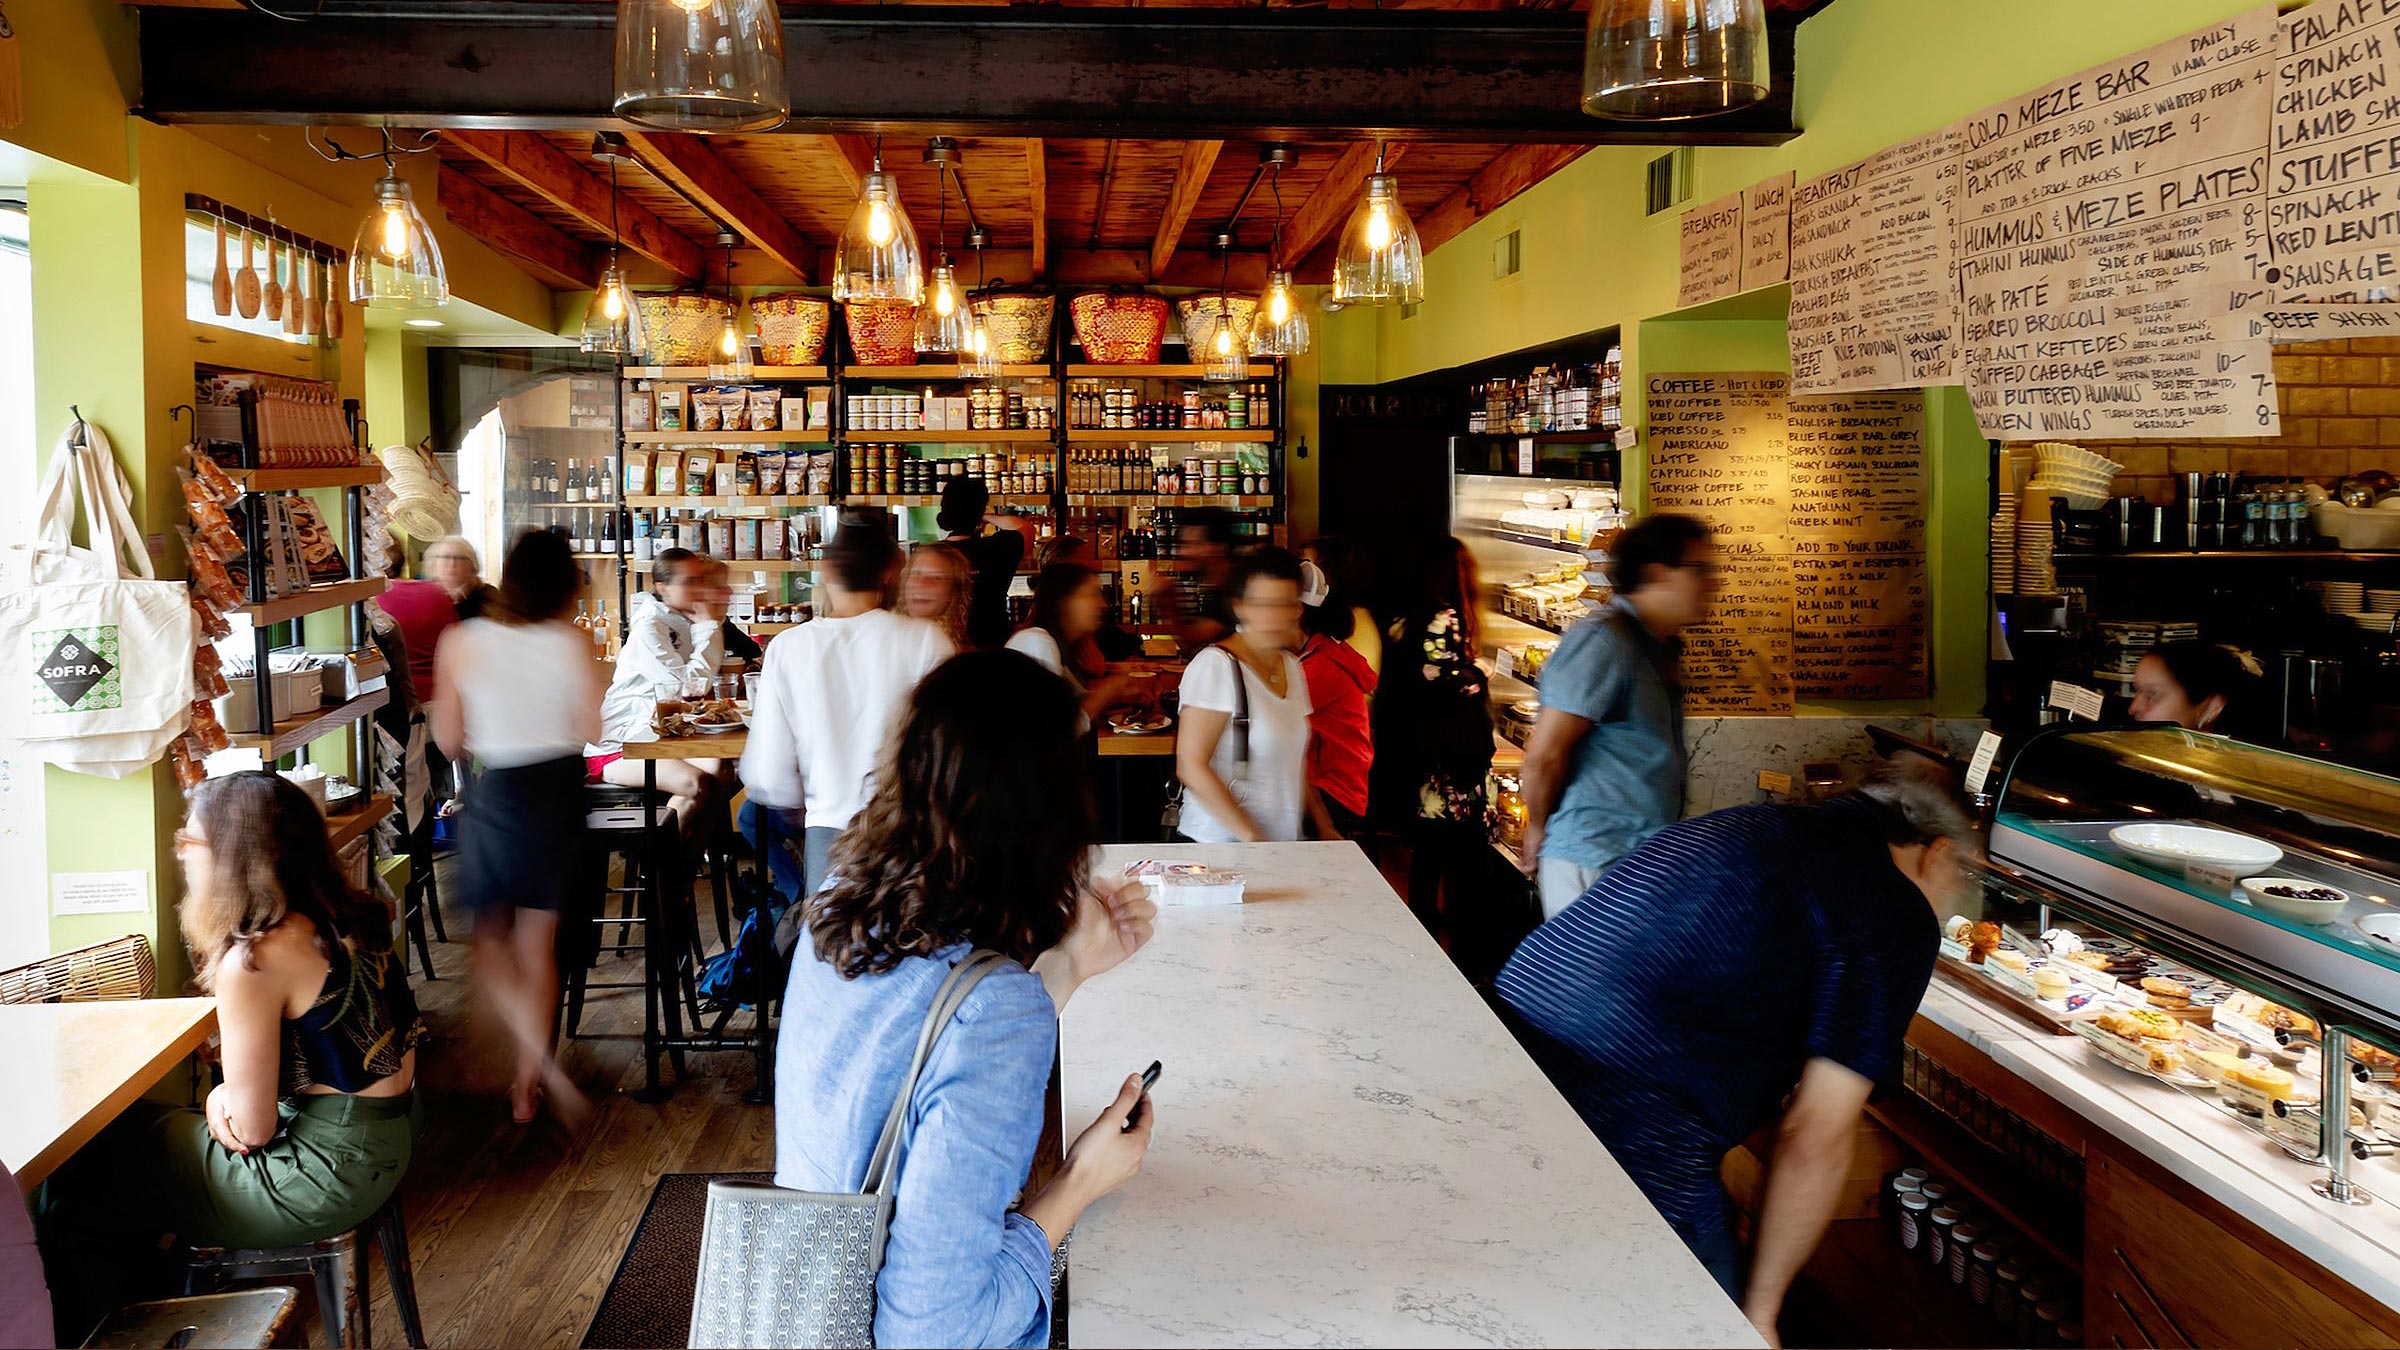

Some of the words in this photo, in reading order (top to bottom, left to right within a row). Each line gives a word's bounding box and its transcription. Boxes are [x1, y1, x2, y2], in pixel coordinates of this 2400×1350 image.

[2190, 24, 2237, 53] DAILY
[2216, 38, 2261, 63] CLOSE
[2280, 34, 2382, 87] SPINACH
[2277, 64, 2386, 114] CHICKEN
[1967, 113, 2008, 149] COLD
[2018, 82, 2084, 130] MEZE
[2096, 61, 2150, 103] BAR
[2279, 109, 2356, 149] LAMB
[2023, 127, 2061, 153] MEZE
[1967, 158, 2028, 198] PLATTER
[2035, 154, 2052, 175] OF
[2059, 138, 2104, 167] FIVE
[2111, 121, 2176, 155] MEZE
[1792, 163, 1866, 209] BREAKFAST
[1755, 186, 1784, 211] LUNCH
[1963, 211, 2044, 257] HUMMUS
[2065, 191, 2145, 233] MEZE
[2160, 157, 2264, 212] PLATES
[2271, 186, 2382, 228] SPINACH
[1682, 207, 1739, 238] BREAKFAST
[1899, 207, 1931, 225] BACON
[2276, 227, 2315, 255] RED
[1963, 256, 2011, 281] TAHINI
[2019, 239, 2076, 269] HUMMUS
[2098, 253, 2129, 272] SIDE
[2134, 252, 2149, 266] OF
[2283, 253, 2397, 291] SAUSAGE
[1967, 318, 2018, 342] SEARED
[2027, 306, 2105, 334] BROCCOLI
[2264, 311, 2321, 329] BEEF
[1841, 323, 1868, 343] PITA
[2037, 332, 2128, 357] KEFTEDES
[1970, 364, 2025, 388] STUFFED
[2031, 359, 2110, 383] CABBAGE
[1650, 378, 1715, 394] COFFEE
[1674, 398, 1722, 408] COFFEE
[2004, 385, 2082, 407] BUTTERED
[2084, 383, 2142, 405] HUMMUS
[1787, 401, 1828, 413] TURKISH
[1829, 402, 1852, 413] TEA
[1650, 412, 1674, 422] ICED
[1679, 411, 1726, 422] COFFEE
[1788, 417, 1839, 427] ENGLISH
[1841, 416, 1903, 427] BREAKFAST
[2041, 409, 2092, 432] WINGS
[1649, 426, 1708, 437] ESPRESSO
[1789, 432, 1815, 441] BLUE
[1818, 431, 1859, 441] FLOWER
[1890, 429, 1919, 441] GREY
[1662, 440, 1730, 451] AMERICANO
[1651, 453, 1699, 465] LATTE
[1790, 460, 1821, 470] SMOKY
[1650, 468, 1723, 479] CAPPUCINO
[1790, 473, 1811, 484] RED
[1814, 474, 1842, 484] CHILI
[1650, 482, 1701, 493] TURKISH
[1704, 481, 1745, 493] COFFEE
[1790, 488, 1838, 499] JASMINE
[1842, 488, 1877, 498] PEARL
[1651, 497, 1686, 507] TURK
[1789, 516, 1829, 527] GREEK
[1833, 515, 1864, 527] MINT
[1796, 542, 1820, 553] ADD
[1825, 543, 1840, 553] TO
[1844, 540, 1871, 552] YOUR
[1875, 540, 1914, 552] DRINK
[1793, 559, 1825, 570] EXTRA
[1130, 572, 1140, 585] 5
[1795, 573, 1819, 583] SKIM
[1859, 571, 1888, 582] MILK
[1795, 586, 1817, 597] SOY
[1824, 586, 1859, 597] MILK
[1797, 600, 1844, 611] ALMOND
[1850, 599, 1880, 611] MILK
[1797, 615, 1820, 626] OAT
[1826, 614, 1861, 625] MILK
[1719, 638, 1743, 647] TEA
[43, 664, 102, 679] SOFRA
